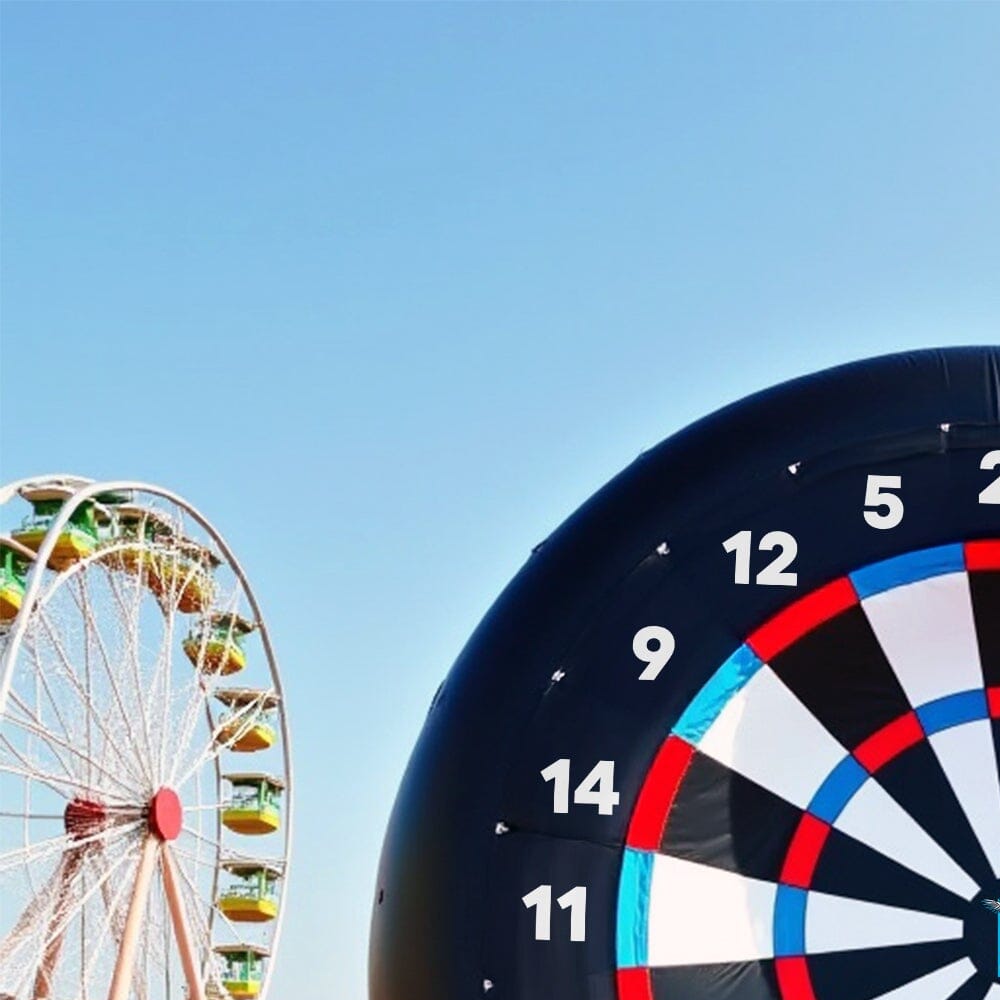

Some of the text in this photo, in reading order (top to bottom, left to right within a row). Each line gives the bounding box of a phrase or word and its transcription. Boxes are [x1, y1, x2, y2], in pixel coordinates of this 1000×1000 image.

[864, 475, 903, 529] 5
[723, 531, 797, 586] 12
[633, 626, 674, 680] 9
[541, 759, 619, 815] 14
[522, 885, 586, 941] 11
